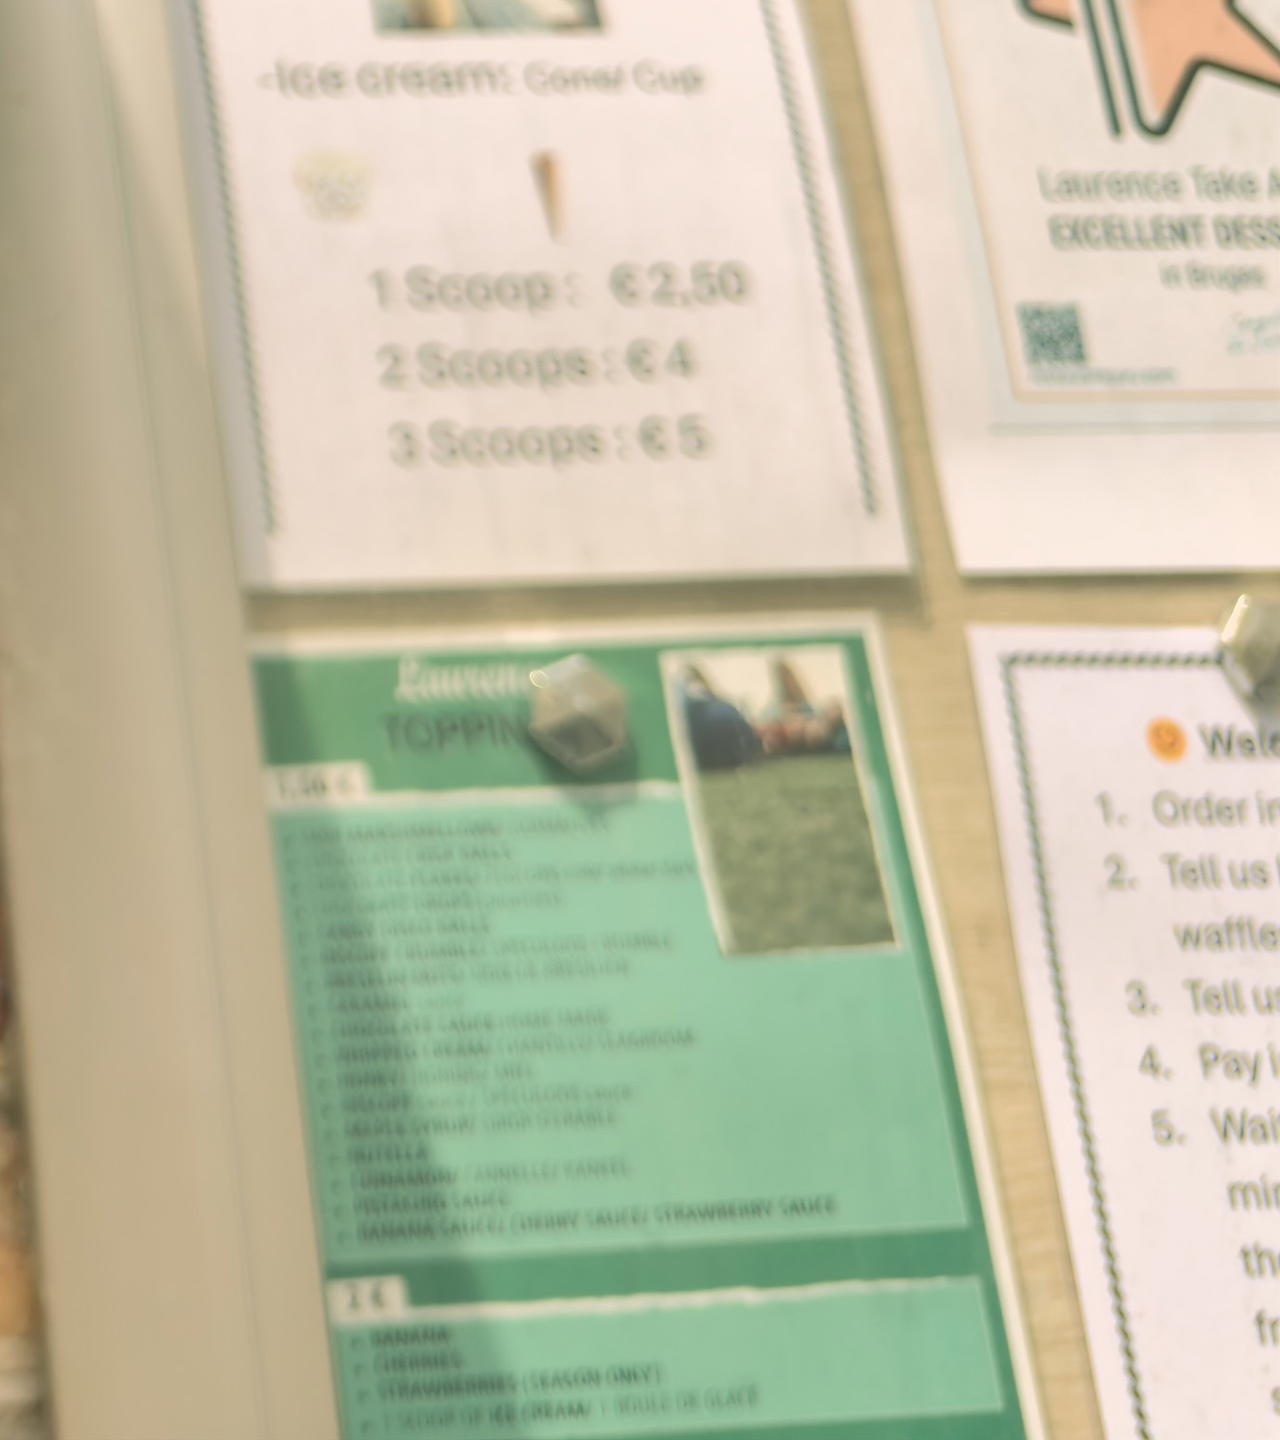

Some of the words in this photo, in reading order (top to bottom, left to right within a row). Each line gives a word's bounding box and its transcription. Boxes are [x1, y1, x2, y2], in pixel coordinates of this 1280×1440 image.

[632, 58, 706, 98] Cup
[1037, 166, 1183, 202] Laurence
[1188, 164, 1259, 202] Take
[1047, 214, 1206, 251] EXCELLENT
[369, 268, 394, 311] 1
[404, 265, 557, 316] Scoop
[608, 261, 642, 307] €
[376, 342, 408, 390] 2
[416, 340, 597, 394] Scoops
[626, 337, 659, 382] €
[664, 337, 700, 380] 4
[387, 420, 421, 468] 3
[426, 417, 607, 471] Scoops
[637, 414, 670, 461] €
[676, 412, 714, 459] 5
[385, 712, 530, 751] TOPPIN
[1095, 791, 1129, 827] 1.
[1152, 789, 1248, 827] Order
[1104, 852, 1138, 891] 2.
[1160, 852, 1223, 890] Tell
[1228, 857, 1272, 890] us
[1125, 978, 1162, 1017] 3.
[1183, 977, 1246, 1016] Tell
[1139, 1043, 1175, 1081] 4.
[1198, 1042, 1263, 1088] Pay
[1151, 1108, 1188, 1146] 5.
[1208, 1106, 1280, 1145] Wai
[1239, 1240, 1280, 1279] th
